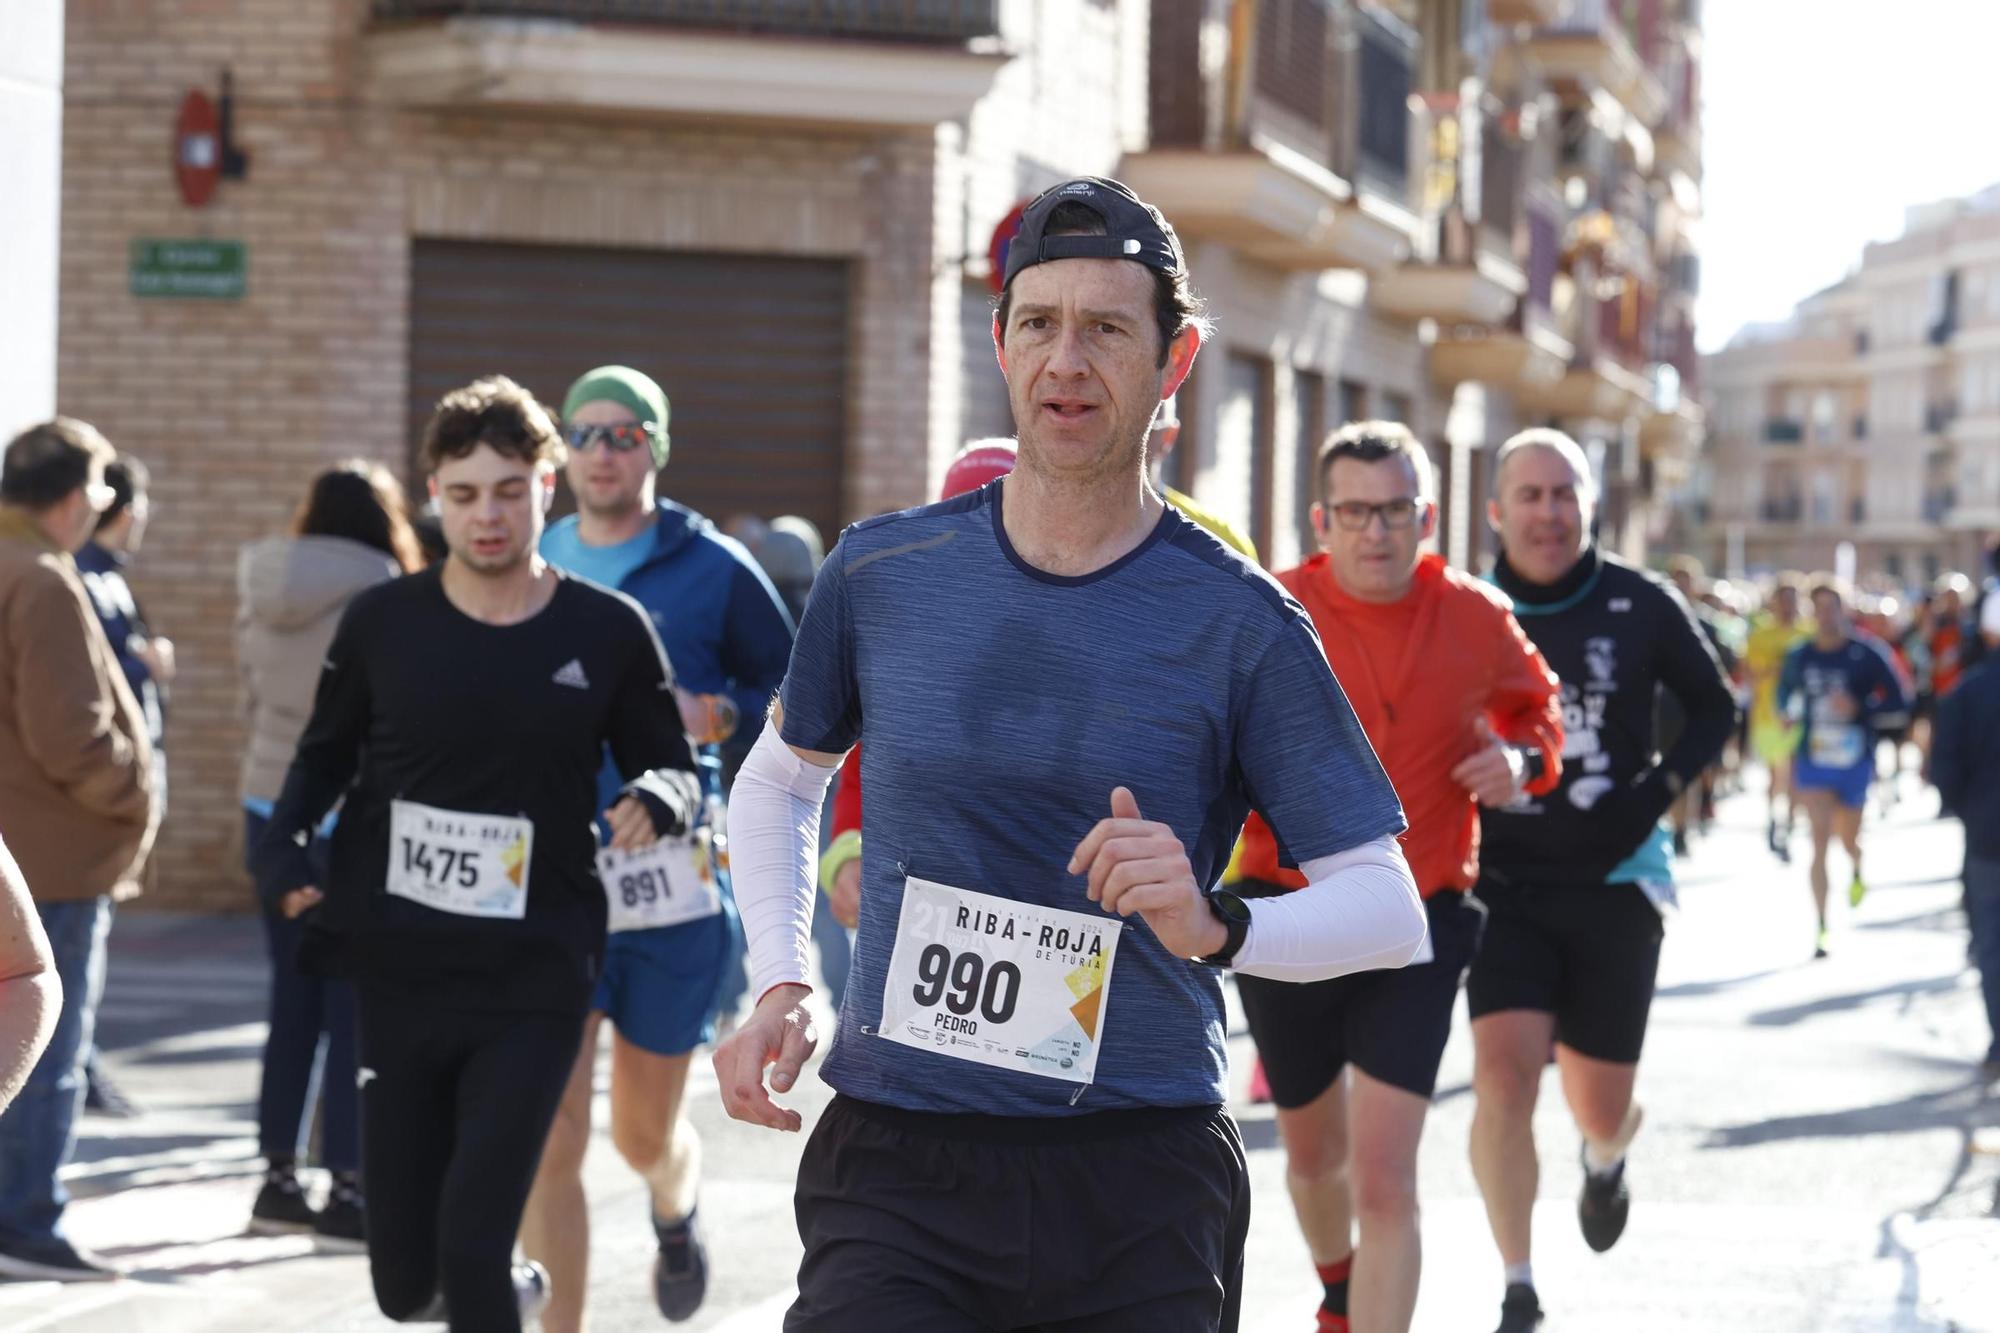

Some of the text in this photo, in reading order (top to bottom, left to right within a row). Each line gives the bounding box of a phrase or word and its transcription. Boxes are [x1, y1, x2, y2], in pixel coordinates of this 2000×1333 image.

[402, 837, 480, 887] 1475
[620, 867, 671, 907] 891
[1035, 949, 1051, 961] DE
[912, 943, 1021, 1024] 990
[934, 1012, 978, 1036] PEDRO
